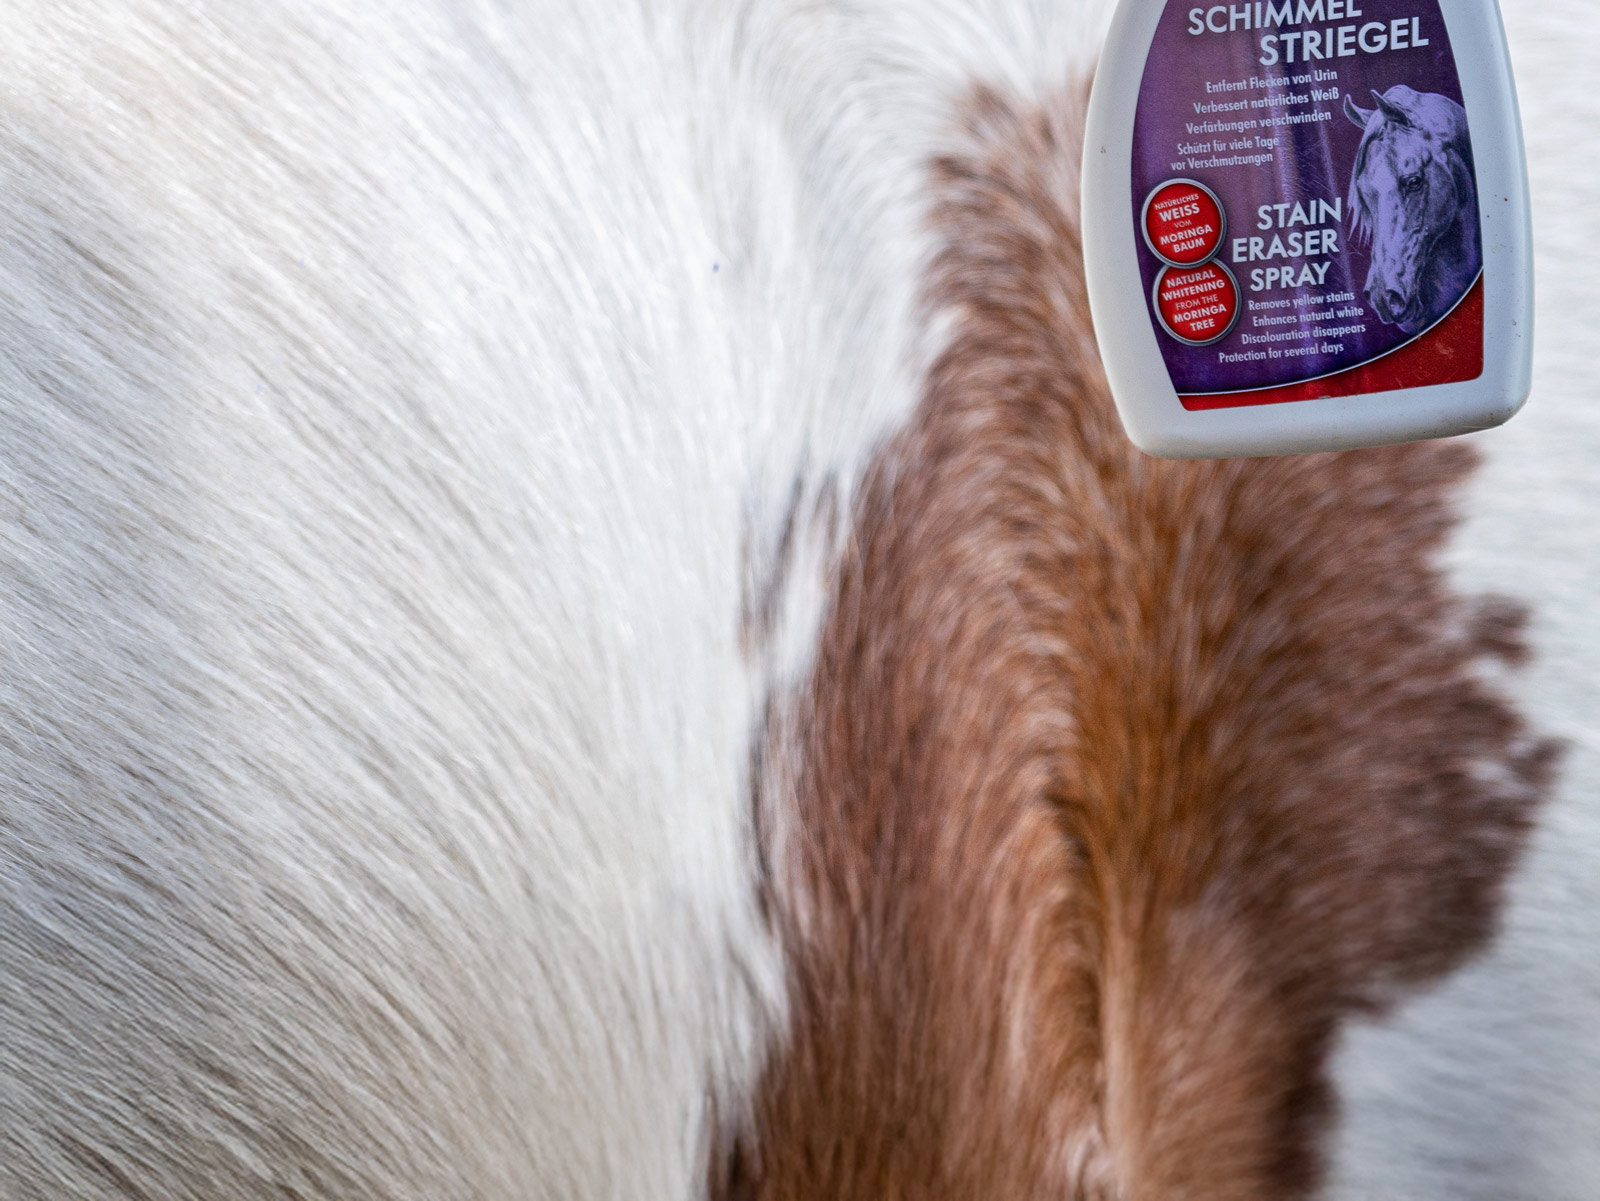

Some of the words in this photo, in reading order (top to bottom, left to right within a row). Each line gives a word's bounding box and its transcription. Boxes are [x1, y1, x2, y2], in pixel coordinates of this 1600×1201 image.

[1258, 16, 1430, 66] STRIEGEL
[1206, 79, 1247, 93] Entfernt
[1250, 75, 1290, 89] Flecken
[1292, 73, 1312, 85] von
[1314, 69, 1338, 82] Urin
[1193, 99, 1248, 114] Verbessert
[1251, 93, 1309, 109] natürliches
[1311, 87, 1339, 101] Weiß
[1185, 118, 1257, 135] Verfärbungen
[1259, 109, 1332, 127] verschwinden
[1177, 141, 1211, 155] Schützt
[1213, 140, 1227, 152] für
[1229, 137, 1253, 150] viele
[1254, 135, 1280, 150] Tage
[1170, 160, 1186, 171] vor
[1187, 153, 1273, 170] Verschmutzungen
[1159, 202, 1200, 222] WEISS
[1256, 197, 1342, 230] STAIN
[1160, 224, 1213, 246] MORINGA
[1174, 219, 1192, 229] VOM
[1172, 237, 1206, 253] BAUM
[1232, 228, 1340, 263] ERASER
[1166, 269, 1216, 288] NATURAL
[1250, 261, 1332, 292] SPRAY
[1161, 279, 1225, 301] WHITENING
[1248, 299, 1291, 311] Removes
[1292, 294, 1324, 307] yellow
[1326, 290, 1355, 303] stains
[1175, 299, 1201, 311] FROM
[1201, 293, 1219, 305] THE
[1173, 303, 1227, 324] MORINGA
[1252, 312, 1298, 327] Enhances
[1300, 308, 1335, 322] natural
[1337, 305, 1364, 318] white
[1189, 318, 1216, 332] TREE
[1241, 330, 1310, 345] Discolouration
[1312, 323, 1366, 339] disappears
[1219, 348, 1267, 364] Protection
[1268, 347, 1282, 359] for
[1284, 343, 1319, 357] several
[1321, 342, 1344, 356] days
